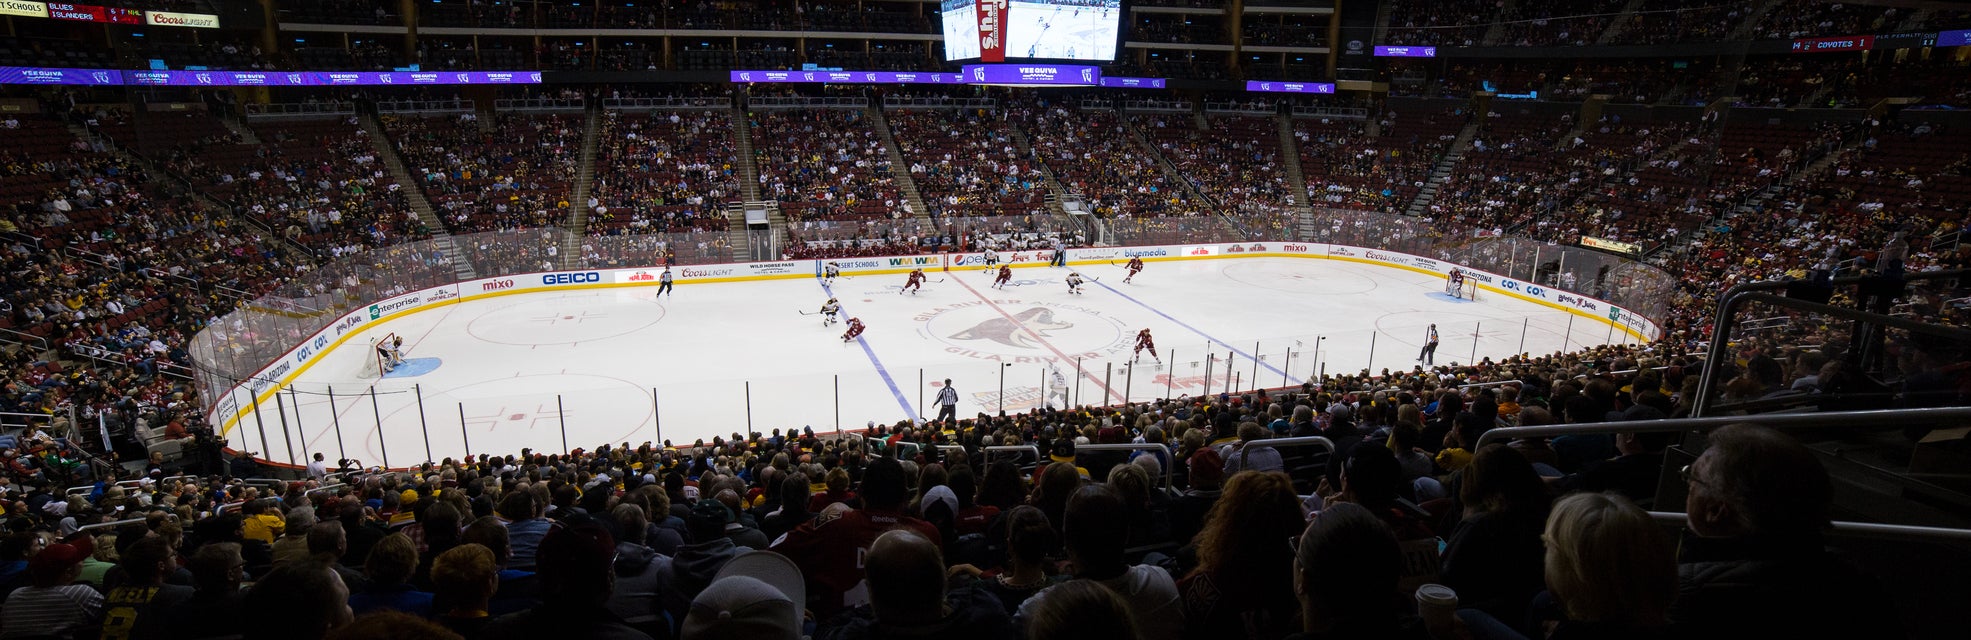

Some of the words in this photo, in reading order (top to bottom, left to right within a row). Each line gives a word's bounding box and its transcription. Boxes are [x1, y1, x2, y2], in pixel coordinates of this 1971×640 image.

[7, 2, 41, 12] SCHOOLS
[52, 11, 94, 20] ISLANDERS
[152, 13, 184, 25] Coors
[1817, 41, 1853, 49] COYOTES
[1124, 247, 1167, 258] bluemedia
[1365, 250, 1387, 261] Coors
[1387, 256, 1409, 264] LIGHT
[855, 260, 879, 268] SCHOOLS
[889, 258, 913, 266] WM
[915, 257, 938, 265] WM
[542, 272, 600, 285] GEICO
[681, 268, 708, 277] Coors
[1501, 279, 1520, 291] COX
[1527, 285, 1546, 298] COX
[371, 297, 419, 316] enterprise
[912, 306, 946, 323] GILA
[949, 298, 1023, 309] RIVER
[314, 334, 328, 350] COX
[297, 345, 312, 362] COX
[944, 346, 1004, 363] GILA
[1014, 350, 1105, 364] RIVER
[268, 360, 291, 382] ARIZONA
[872, 515, 898, 523] Reebok
